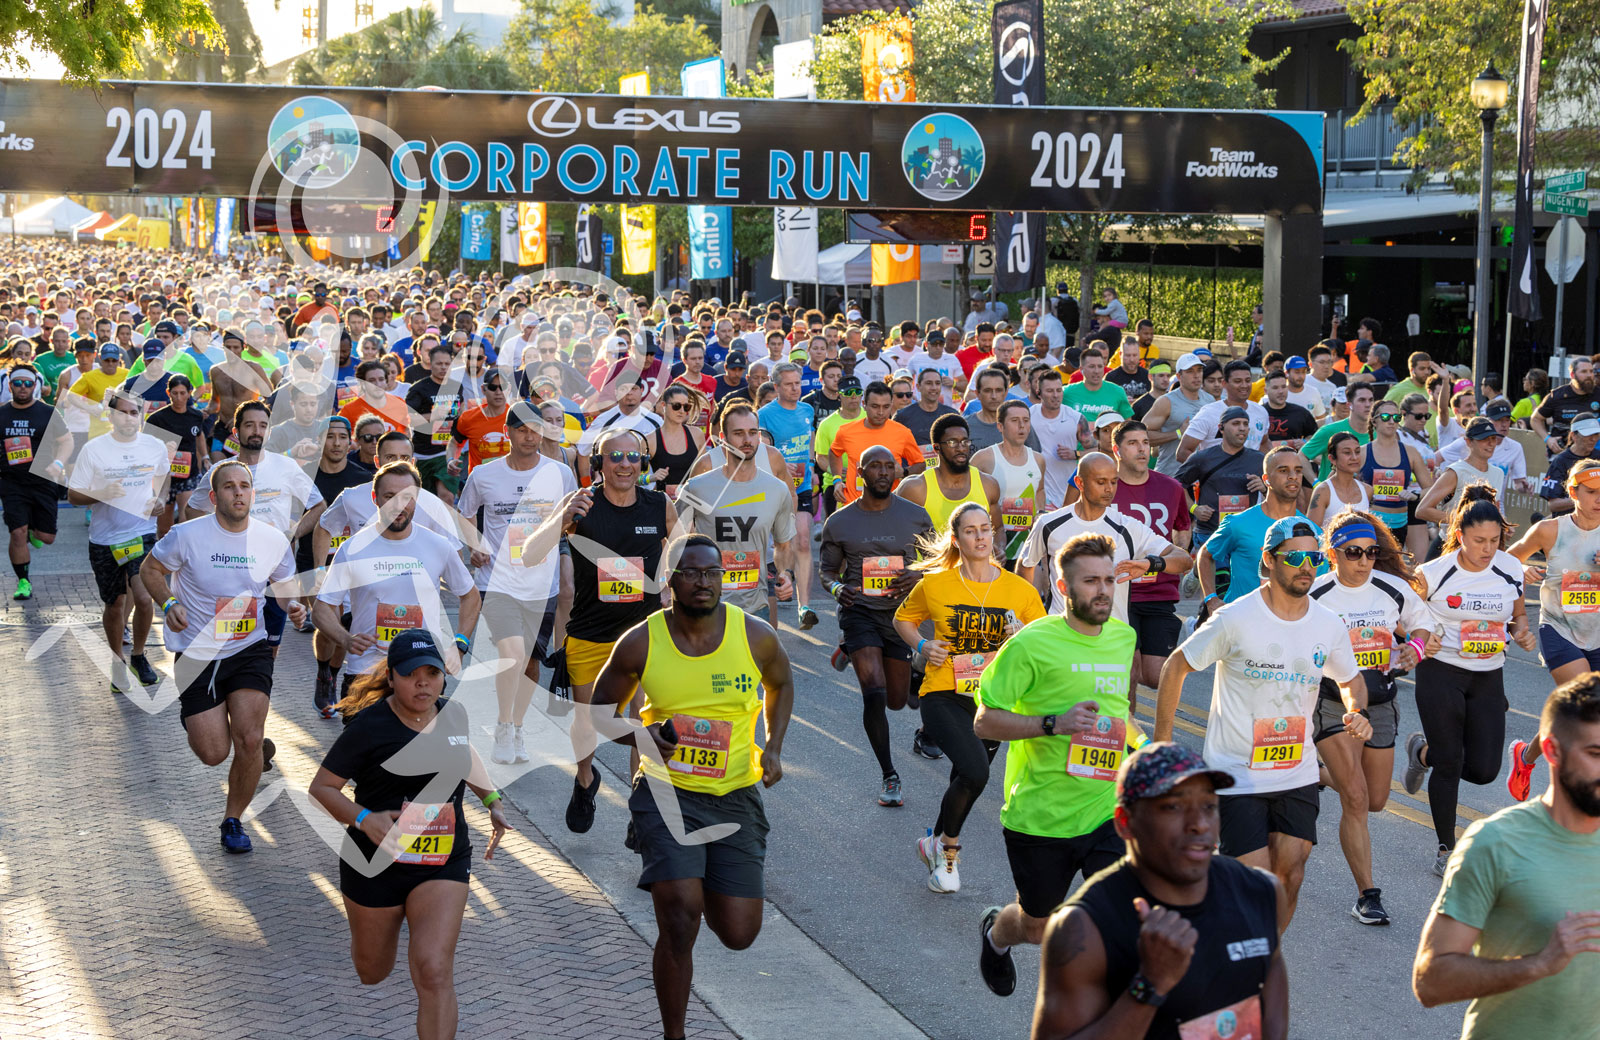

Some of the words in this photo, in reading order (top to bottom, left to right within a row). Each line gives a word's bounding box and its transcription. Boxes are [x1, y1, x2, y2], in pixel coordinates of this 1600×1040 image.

[586, 106, 741, 134] LEXUS
[106, 107, 216, 170] 2024
[1030, 131, 1126, 189] 2024
[1210, 147, 1255, 162] Team
[390, 140, 740, 198] CORPORATE
[768, 149, 870, 201] RUN
[1186, 161, 1278, 178] FootWorks
[1547, 195, 1575, 207] NUGENT
[1578, 200, 1586, 209] AV
[968, 214, 987, 240] 6
[12, 420, 29, 428] THE
[5, 428, 36, 436] FAMILY
[10, 450, 28, 460] 1389
[171, 464, 186, 473] 395
[1377, 485, 1399, 495] 2802
[1007, 515, 1028, 526] 1608
[715, 516, 758, 543] EY
[124, 548, 130, 556] 6
[211, 553, 256, 564] shipmonk
[374, 561, 424, 572] shipmonk
[730, 571, 748, 582] 871
[610, 581, 633, 595] 426
[1568, 592, 1597, 605] 2556
[223, 619, 249, 633] 1991
[957, 610, 1004, 635] TEAM
[1468, 642, 1498, 654] 2806
[1255, 662, 1285, 670] LEXUS
[1354, 651, 1383, 667] 2801
[1244, 668, 1307, 684] CORPORATE
[1094, 676, 1128, 695] RSM
[679, 747, 718, 767] 1133
[1081, 747, 1116, 769] 1940
[1263, 746, 1294, 761] 1291
[411, 836, 440, 853] 421
